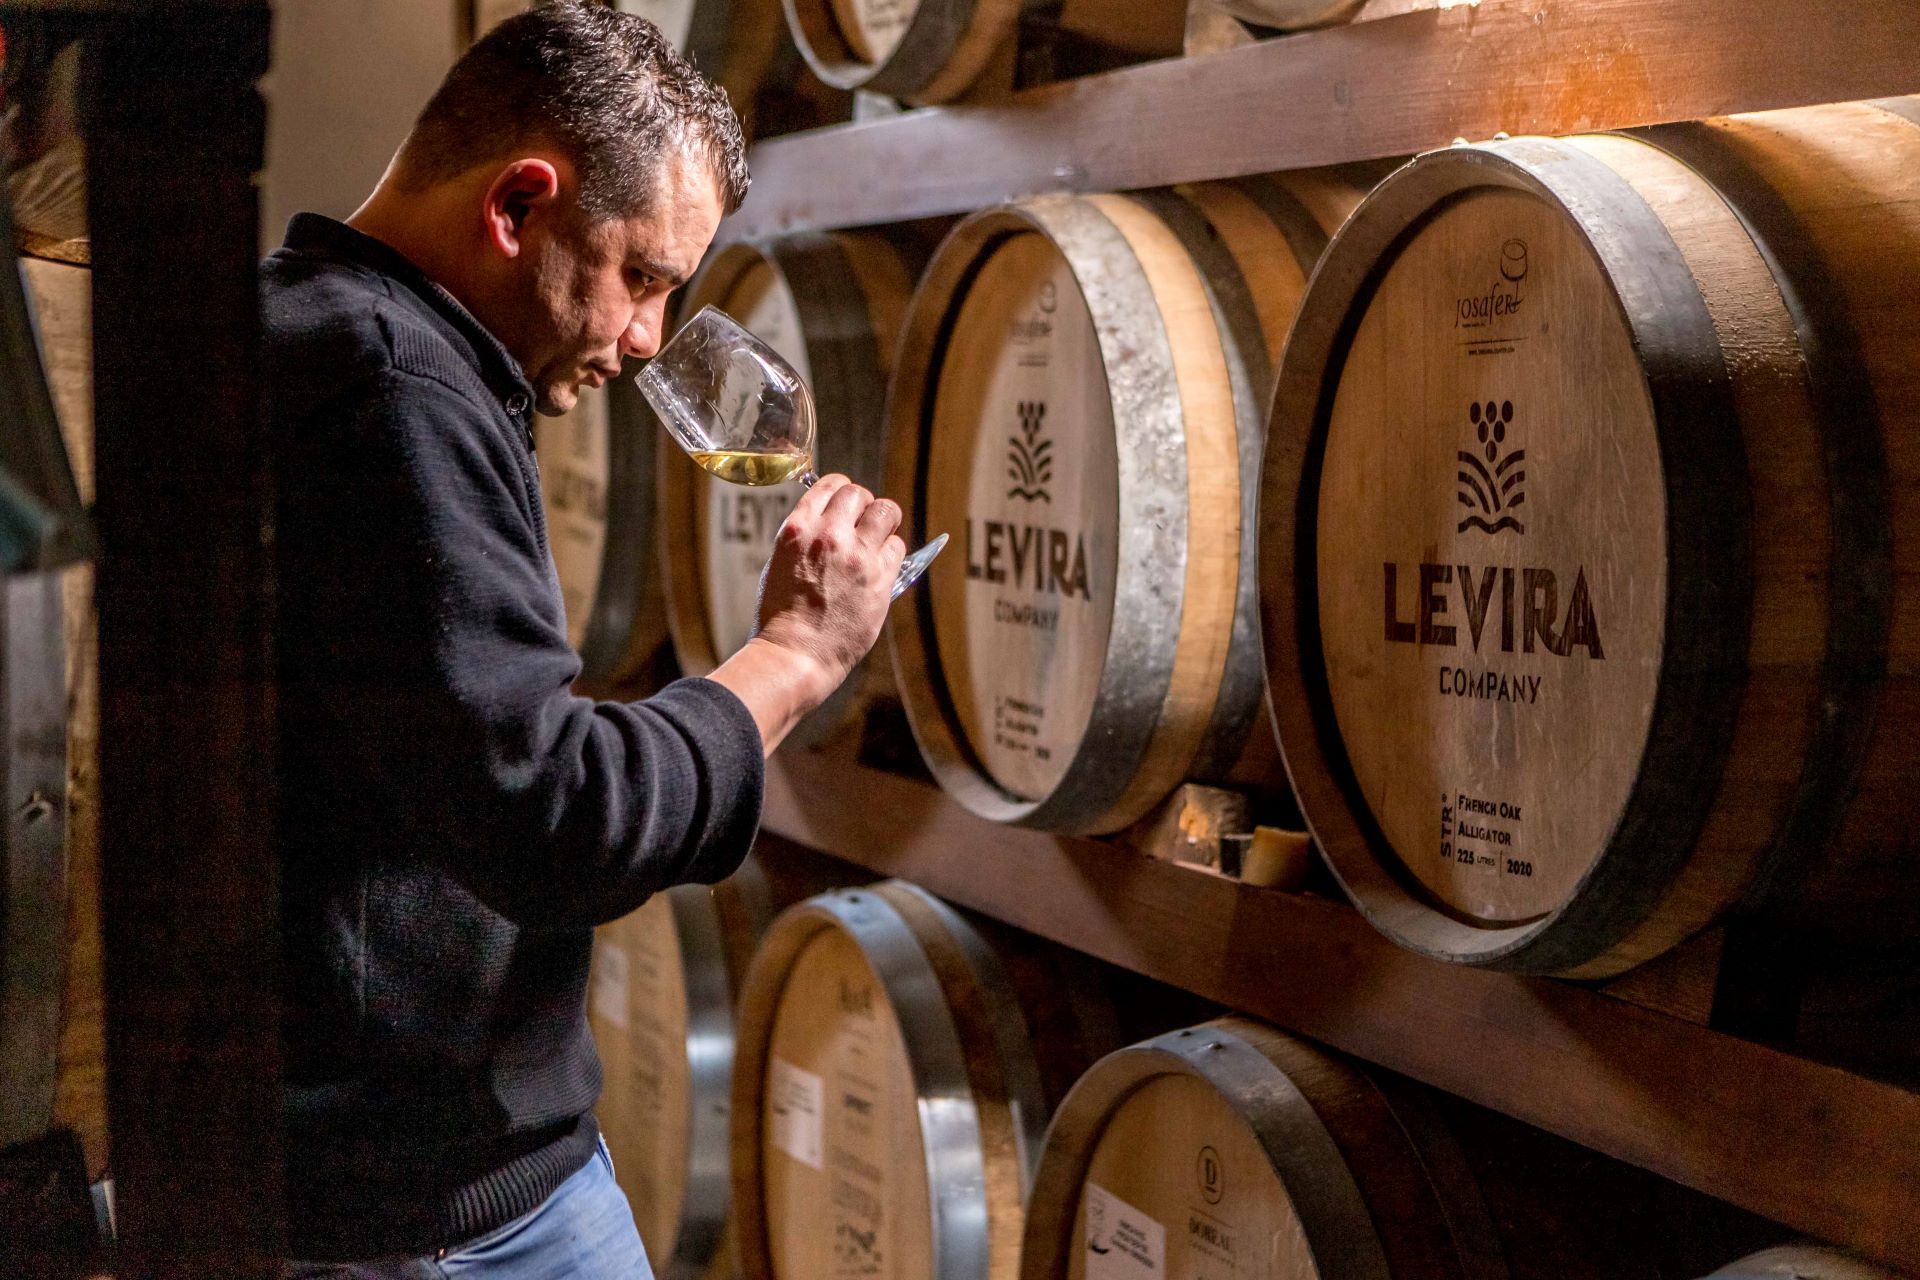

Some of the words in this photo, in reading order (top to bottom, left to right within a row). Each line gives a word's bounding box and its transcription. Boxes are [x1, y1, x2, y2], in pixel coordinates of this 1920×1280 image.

[965, 519, 1091, 602] LEVIRA
[1383, 562, 1606, 660] LEVIRA
[1439, 666, 1542, 704] COMPANY
[1457, 848, 1475, 865] 225
[1507, 859, 1533, 877] 2020
